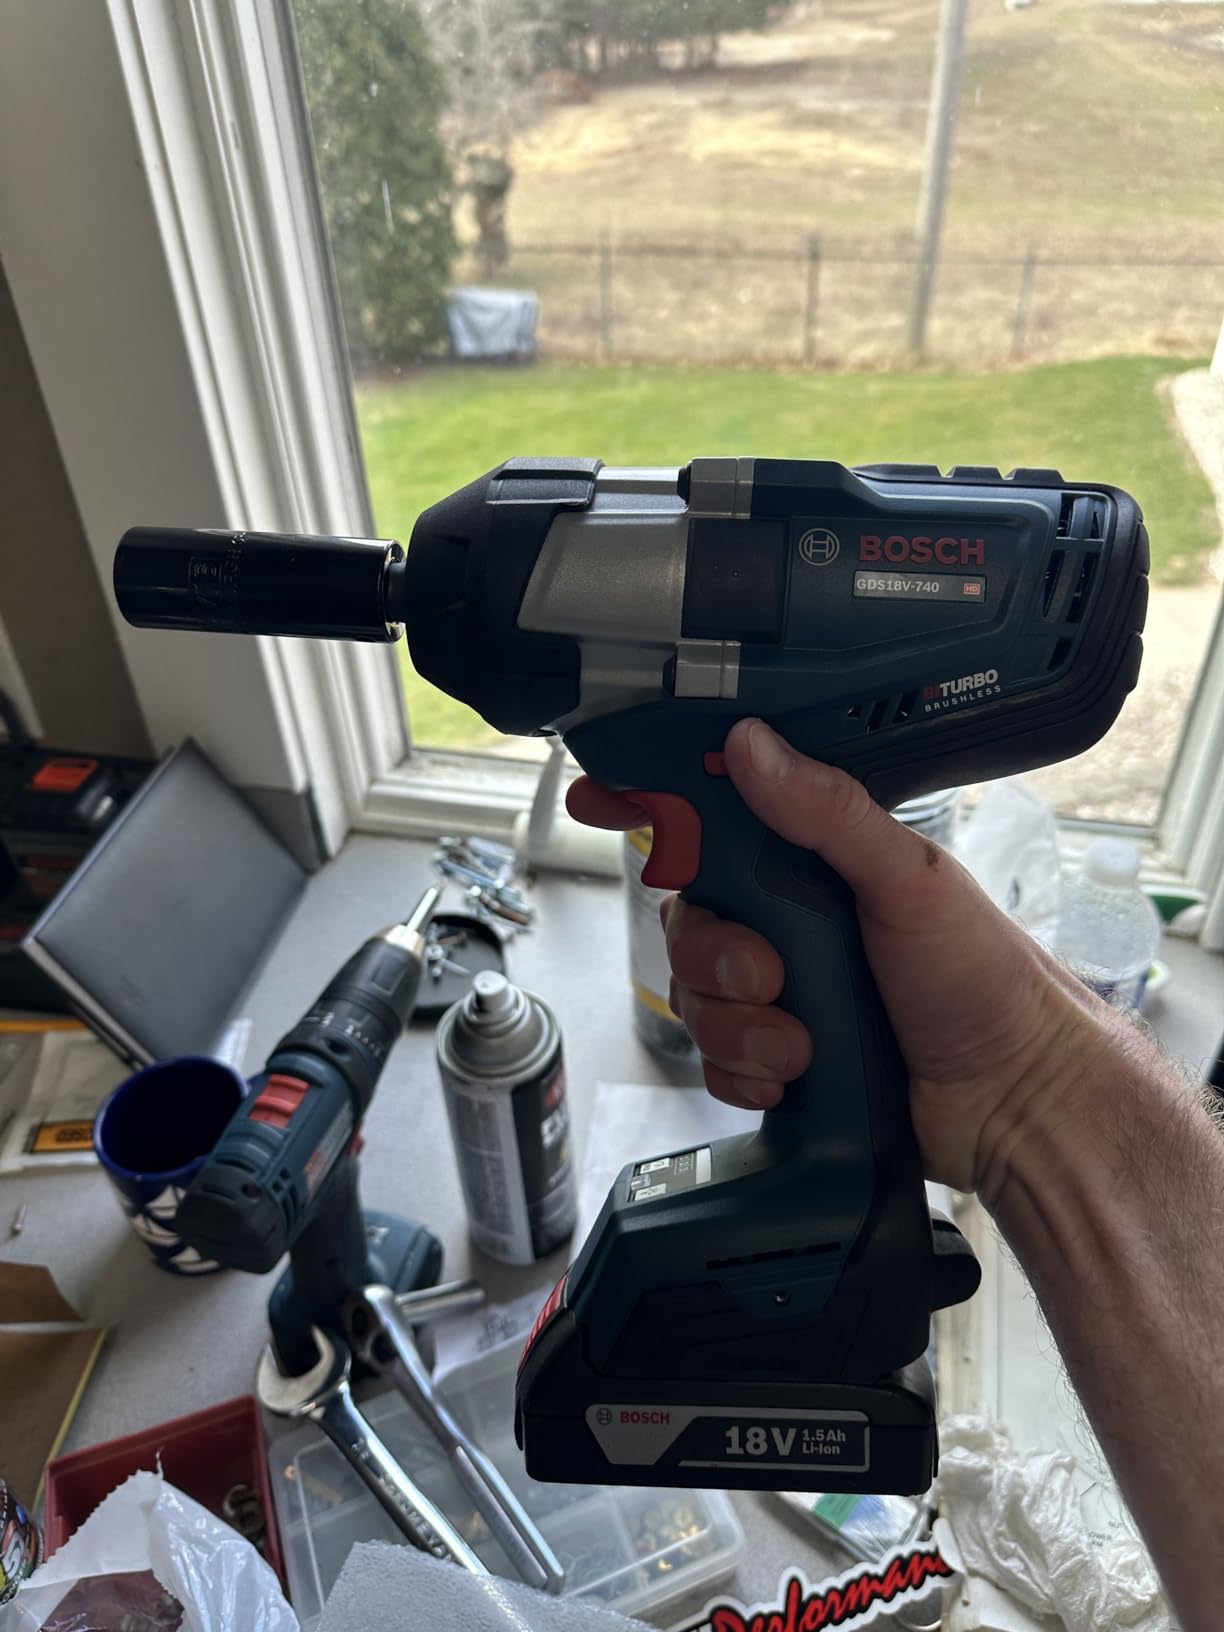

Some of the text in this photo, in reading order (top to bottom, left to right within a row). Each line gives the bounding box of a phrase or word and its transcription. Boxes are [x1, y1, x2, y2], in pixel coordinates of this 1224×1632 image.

[859, 535, 985, 565] BOSCH
[856, 578, 940, 593] GDS18V-740
[925, 685, 1001, 712] BRUSHLESS
[620, 1411, 670, 1424] BOSCH
[725, 1426, 847, 1456] 18V 1.5Ah
[802, 1443, 841, 1455] Li-Ion
